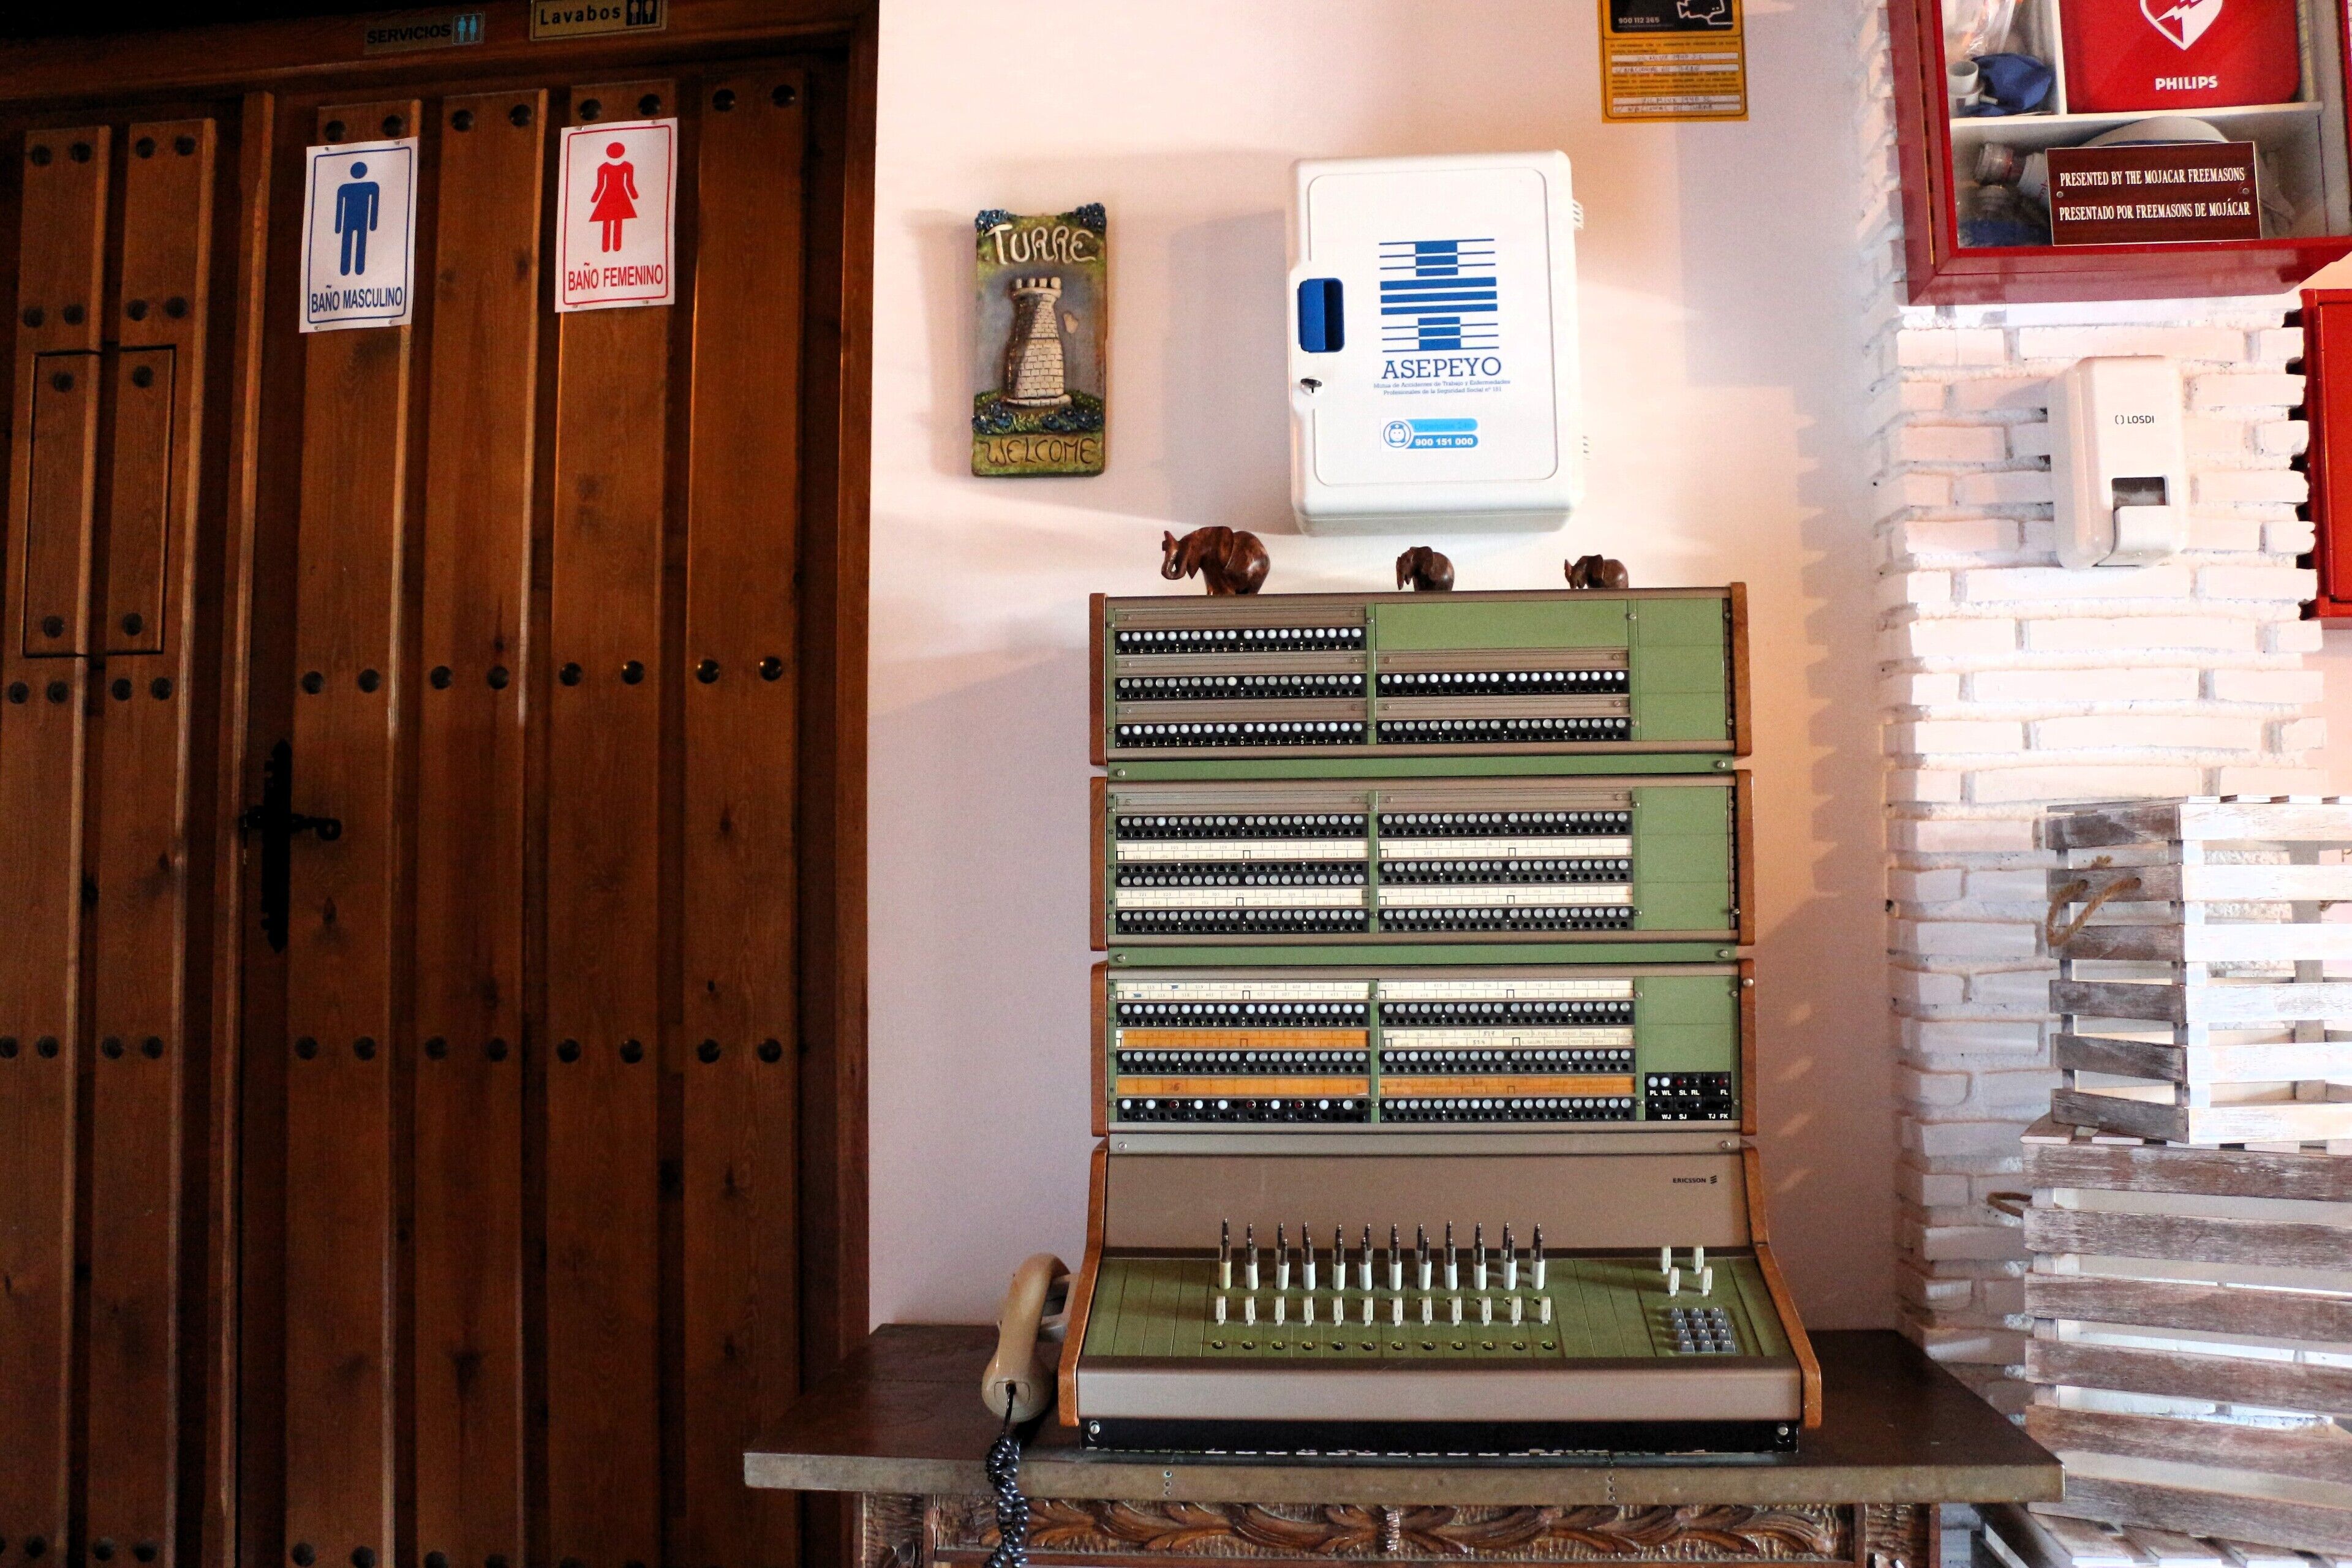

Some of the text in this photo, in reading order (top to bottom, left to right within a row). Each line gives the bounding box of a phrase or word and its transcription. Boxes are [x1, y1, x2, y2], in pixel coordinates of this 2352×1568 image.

[540, 5, 620, 25] Lavabos
[367, 24, 451, 43] SERVICIOS
[2155, 75, 2218, 90] PHILIPS
[2060, 167, 2245, 187] PRESENTED BY THE MOJACAR FREEMASONS
[2059, 198, 2251, 221] PRESENTADO POR FREEMASONS DE MOJÁCAR
[985, 224, 1096, 265] TURRE
[568, 262, 663, 291] BAÑO FEMENINO
[311, 284, 403, 313] BAÑO MASCULINO
[1381, 356, 1502, 379] ASEPEYO
[2127, 415, 2154, 424] LOSDI
[979, 436, 1096, 466] WELCOME
